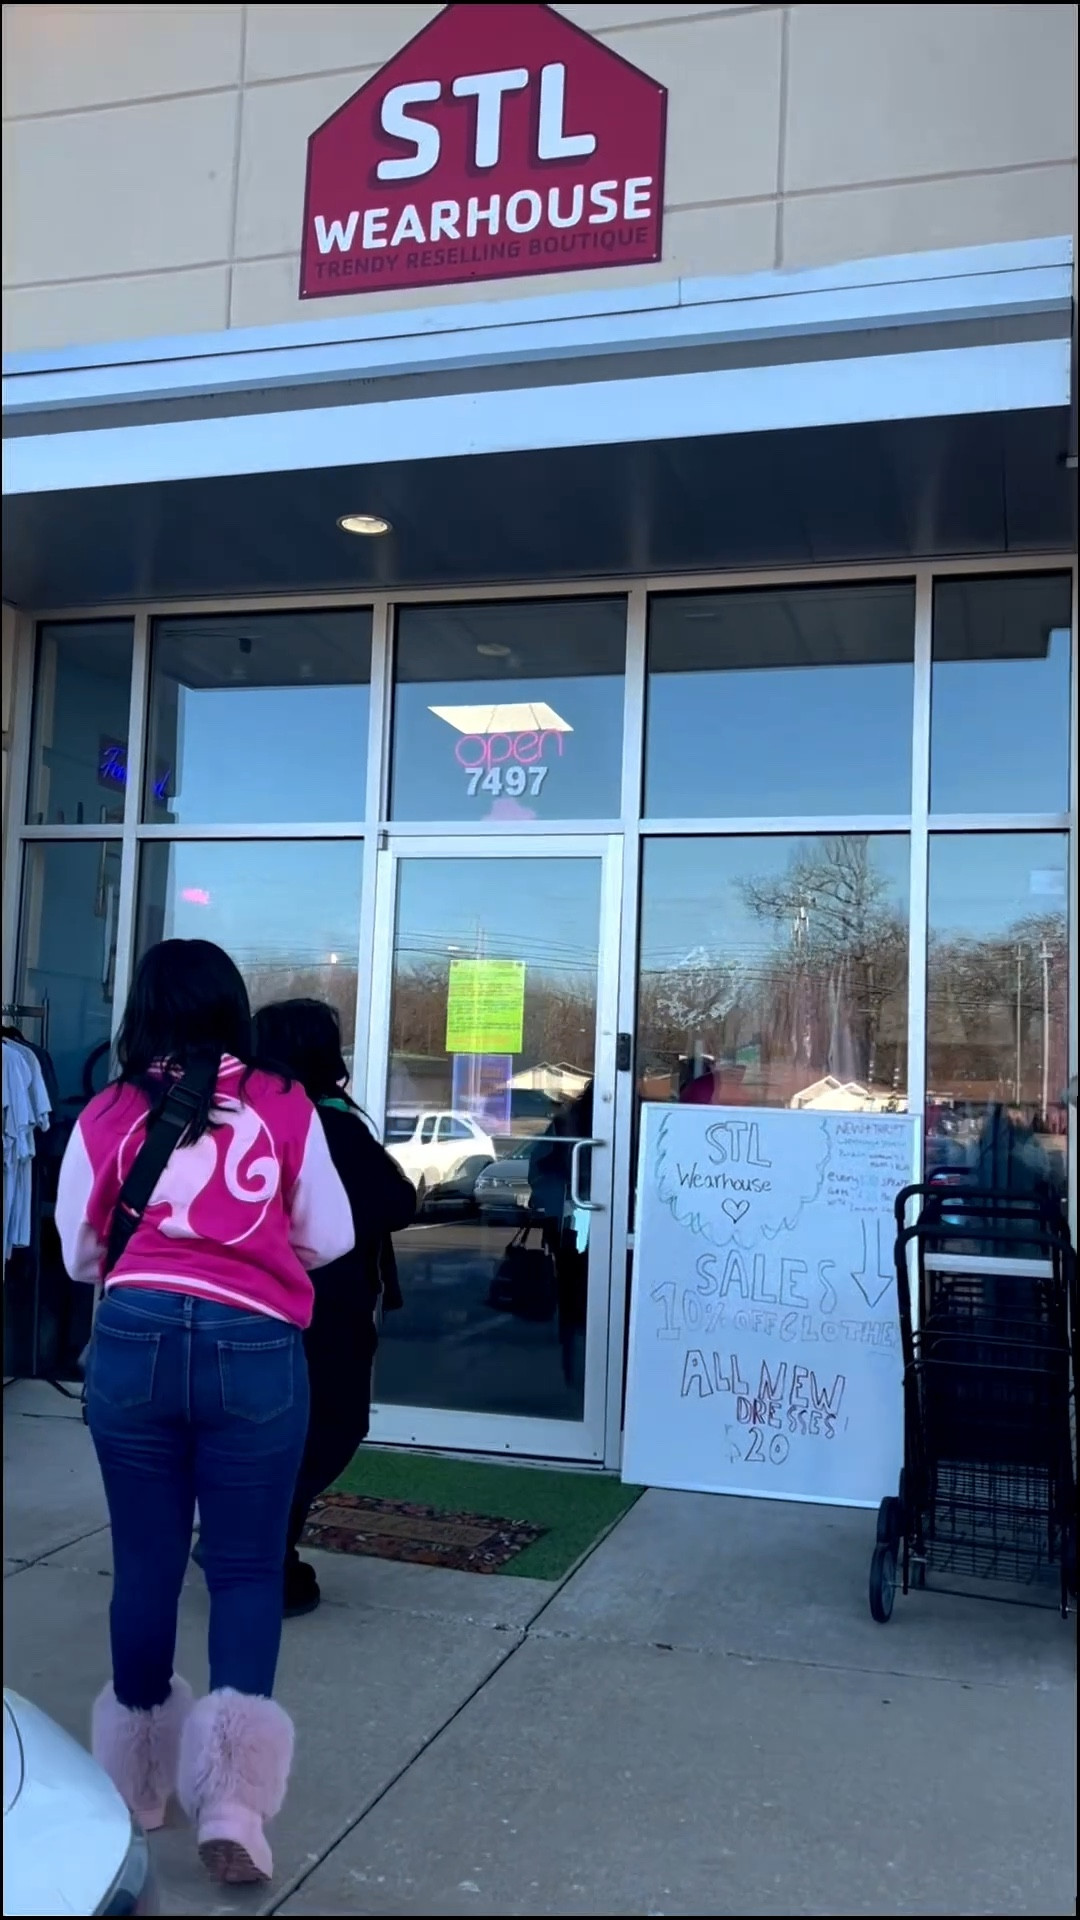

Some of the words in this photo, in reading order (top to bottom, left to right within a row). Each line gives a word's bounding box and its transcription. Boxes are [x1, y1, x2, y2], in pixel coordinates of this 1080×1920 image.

[377, 62, 596, 181] STL
[314, 176, 653, 254] WEARHOUSE
[316, 253, 399, 279] TRENDY
[406, 239, 521, 269] RESELLING
[529, 226, 648, 256] BOUTIQUE
[455, 728, 563, 770] open
[464, 765, 547, 796] 7497
[705, 1120, 773, 1168] STL
[677, 1162, 772, 1193] Wearhouse
[696, 1249, 838, 1315] SALES
[650, 1281, 727, 1341] 10%
[733, 1310, 778, 1336] OFF
[681, 1349, 749, 1398] ALL
[758, 1359, 846, 1415] NEW
[736, 1396, 837, 1440] DRESSES
